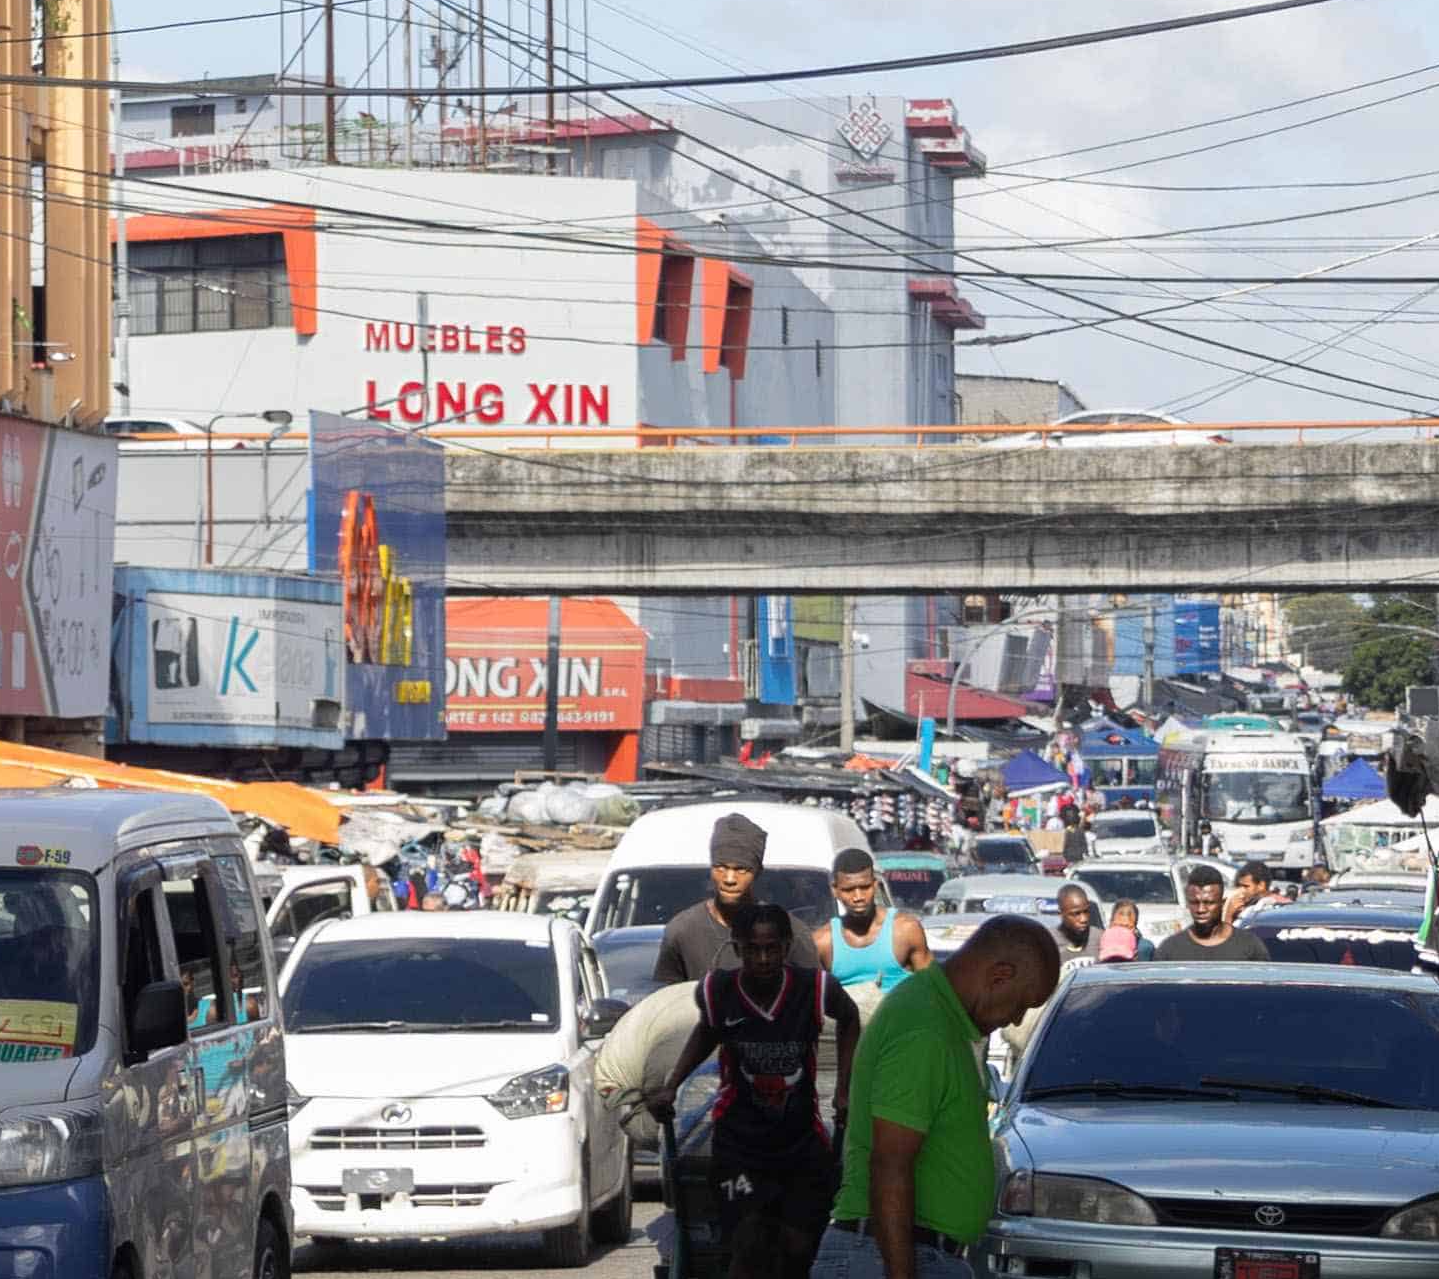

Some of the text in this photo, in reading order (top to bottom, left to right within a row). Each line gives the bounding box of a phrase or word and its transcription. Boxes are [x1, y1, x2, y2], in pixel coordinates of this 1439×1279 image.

[363, 322, 528, 355] MUEBLES
[366, 380, 611, 426] LONG XIN
[526, 657, 602, 698] XIN
